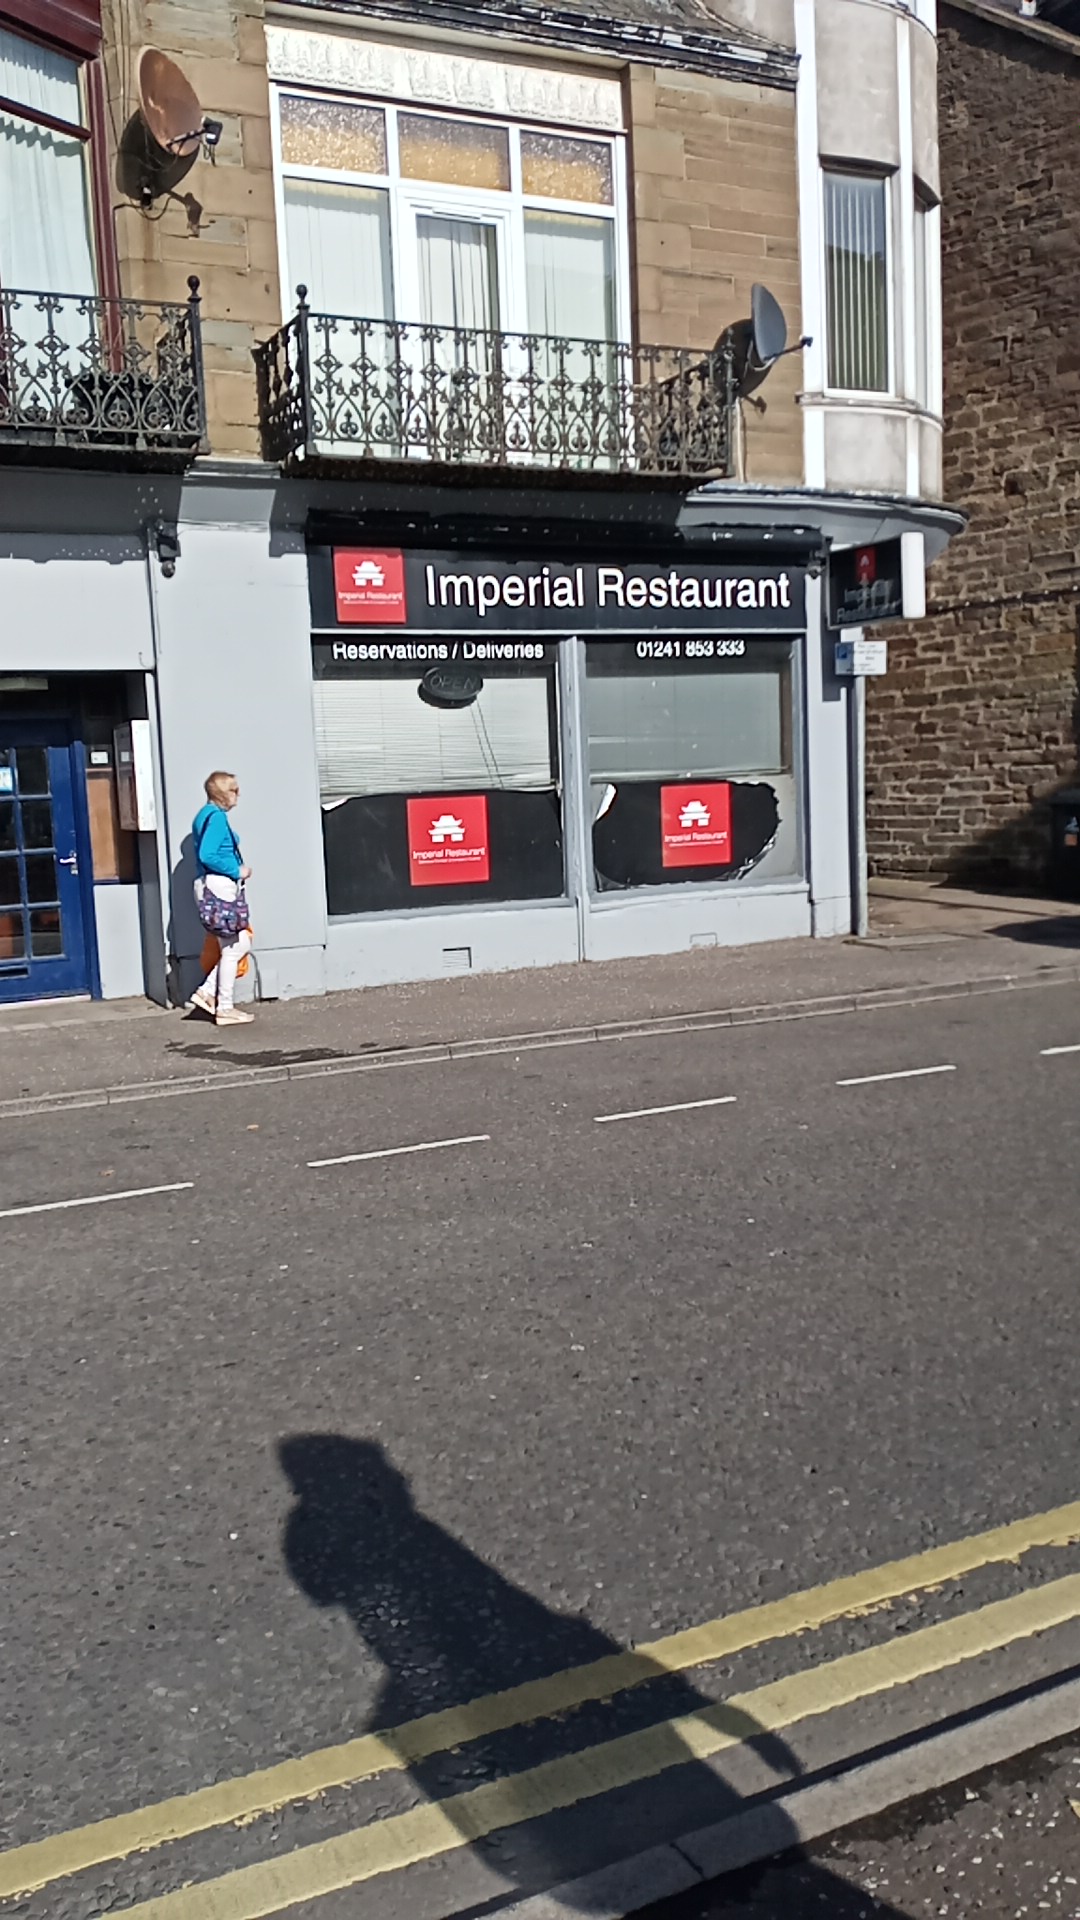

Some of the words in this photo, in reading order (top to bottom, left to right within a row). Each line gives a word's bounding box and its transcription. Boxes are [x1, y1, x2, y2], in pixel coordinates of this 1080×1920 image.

[426, 564, 585, 617] Imperial
[597, 567, 791, 609] Restaurant
[332, 641, 449, 660] Reservations
[463, 642, 545, 660] Deliveries
[636, 640, 681, 659] 01241
[685, 640, 714, 657] 853
[716, 639, 746, 656] 333
[429, 674, 478, 690] OPEN
[412, 848, 444, 860] Imperial
[445, 847, 486, 858] Restaurant
